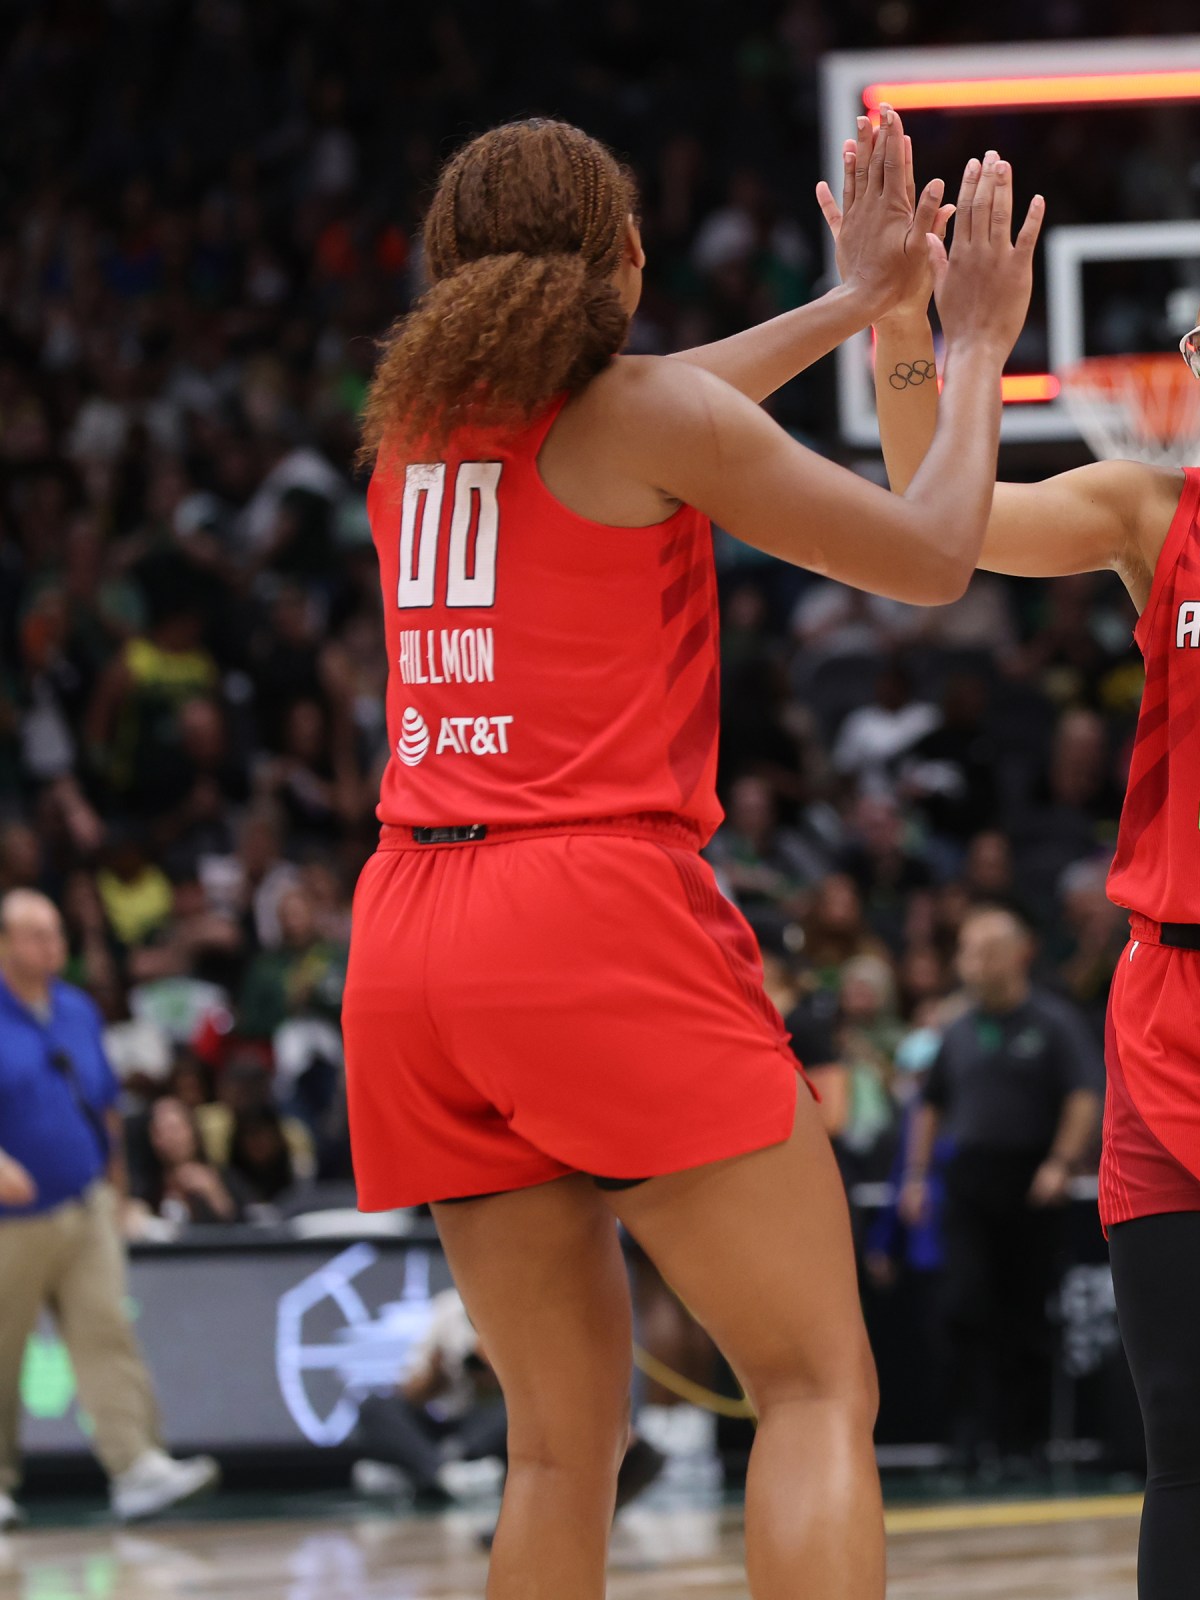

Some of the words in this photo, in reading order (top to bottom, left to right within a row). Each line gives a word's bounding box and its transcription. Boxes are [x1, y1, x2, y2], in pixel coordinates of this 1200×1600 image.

[397, 460, 503, 609] 00
[398, 627, 495, 684] HILLMON
[435, 715, 514, 755] AT&T
